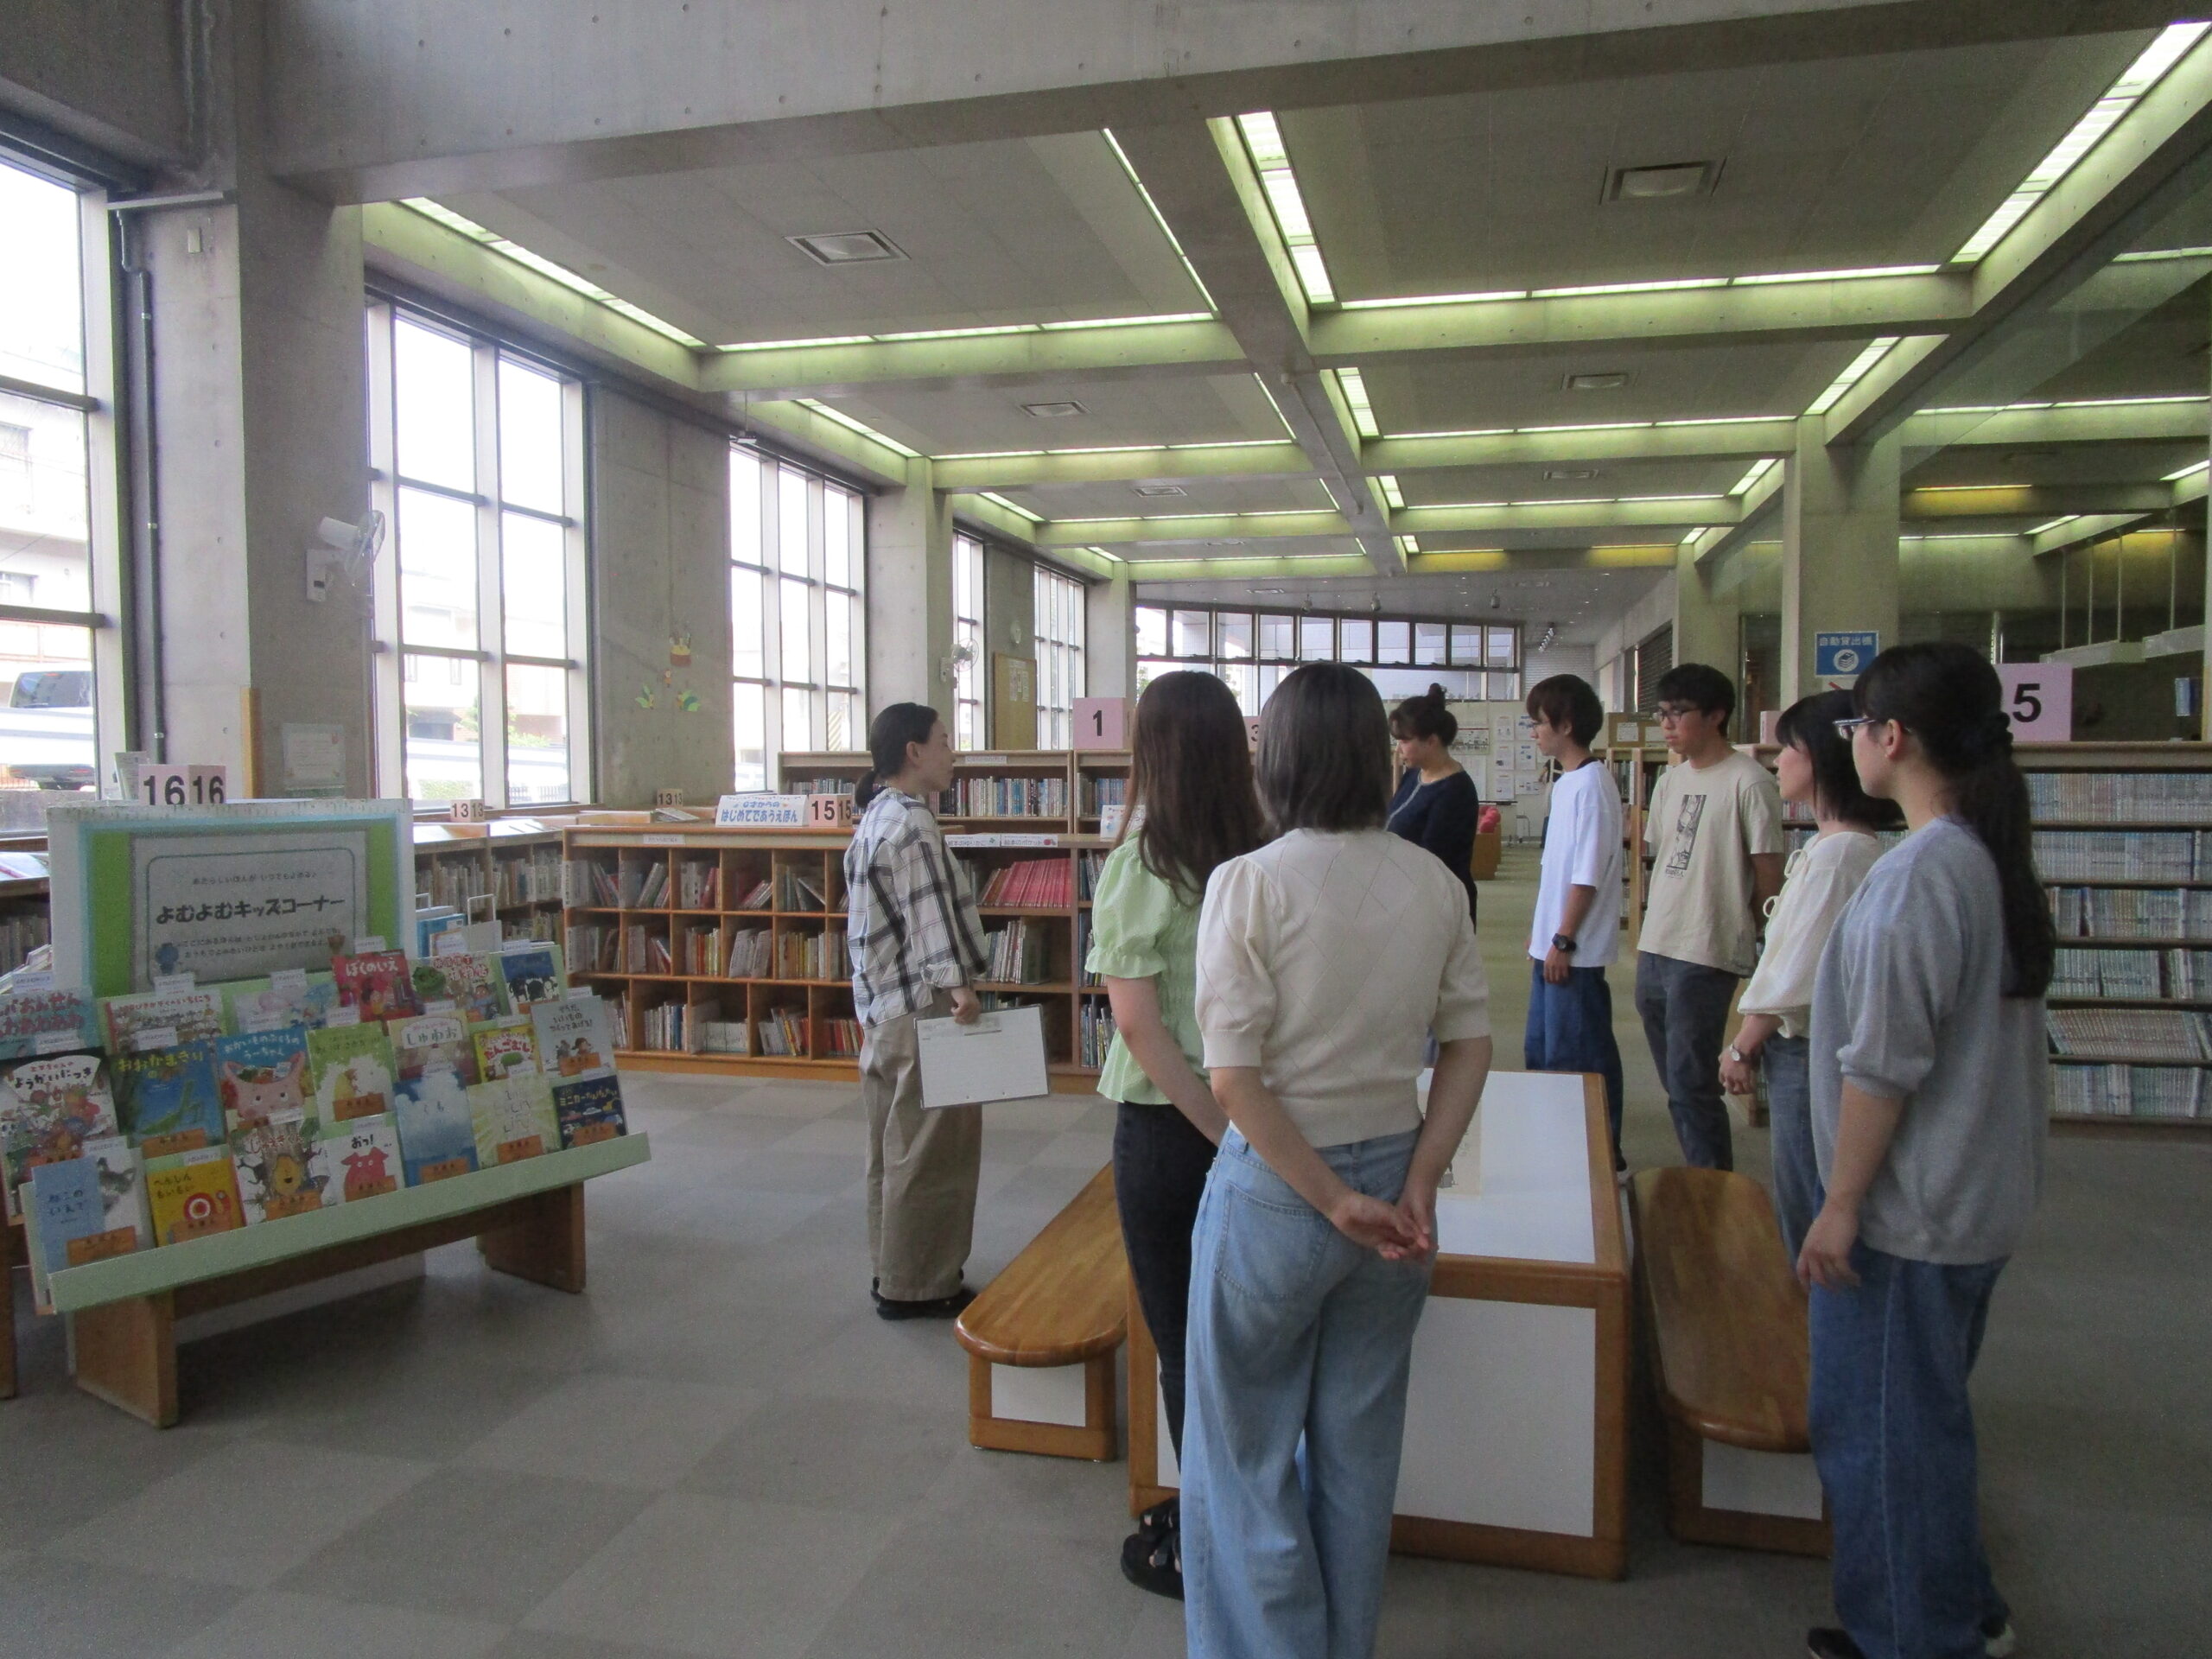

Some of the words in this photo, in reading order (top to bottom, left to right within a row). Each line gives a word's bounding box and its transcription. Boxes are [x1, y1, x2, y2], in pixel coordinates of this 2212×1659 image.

[1819, 636, 1873, 646] 自動貸出機
[2012, 683, 2042, 722] 5
[1093, 710, 1103, 736] 1
[143, 775, 185, 805] 16
[193, 775, 225, 804] 16
[658, 793, 672, 805] 13
[452, 802, 469, 818] 13
[472, 802, 484, 818] 13
[721, 808, 798, 823] はじめてであうえほん
[811, 800, 836, 821] 15
[839, 800, 852, 820] 15
[156, 894, 346, 925] よむよむキッズコーナー
[346, 957, 399, 977] ぼくのいえ
